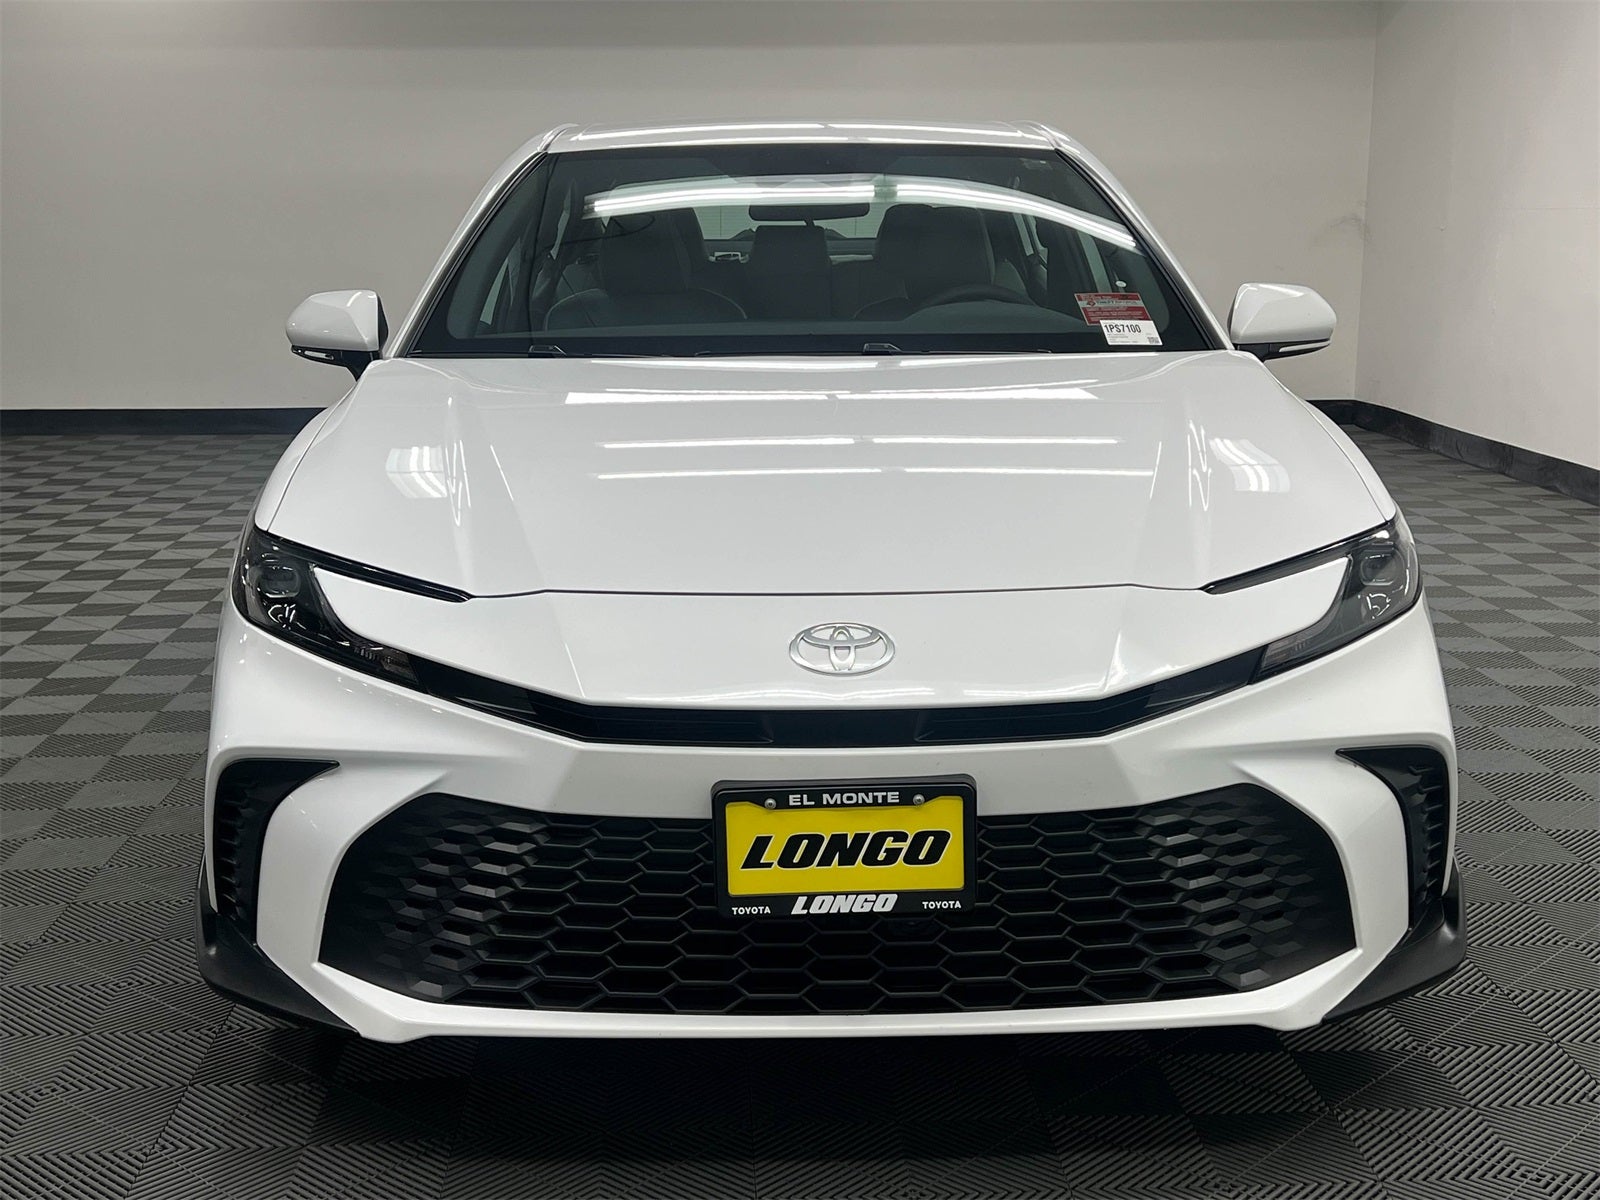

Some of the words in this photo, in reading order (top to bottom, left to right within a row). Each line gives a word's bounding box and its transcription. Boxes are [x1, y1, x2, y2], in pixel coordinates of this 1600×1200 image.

[1104, 324, 1142, 333] 1PS7100
[788, 793, 815, 806] EL
[822, 791, 900, 805] MONTE
[740, 829, 952, 870] LONGO
[732, 905, 771, 915] TOYOTA
[791, 893, 898, 915] LONGO
[922, 900, 962, 910] TOYOTA
